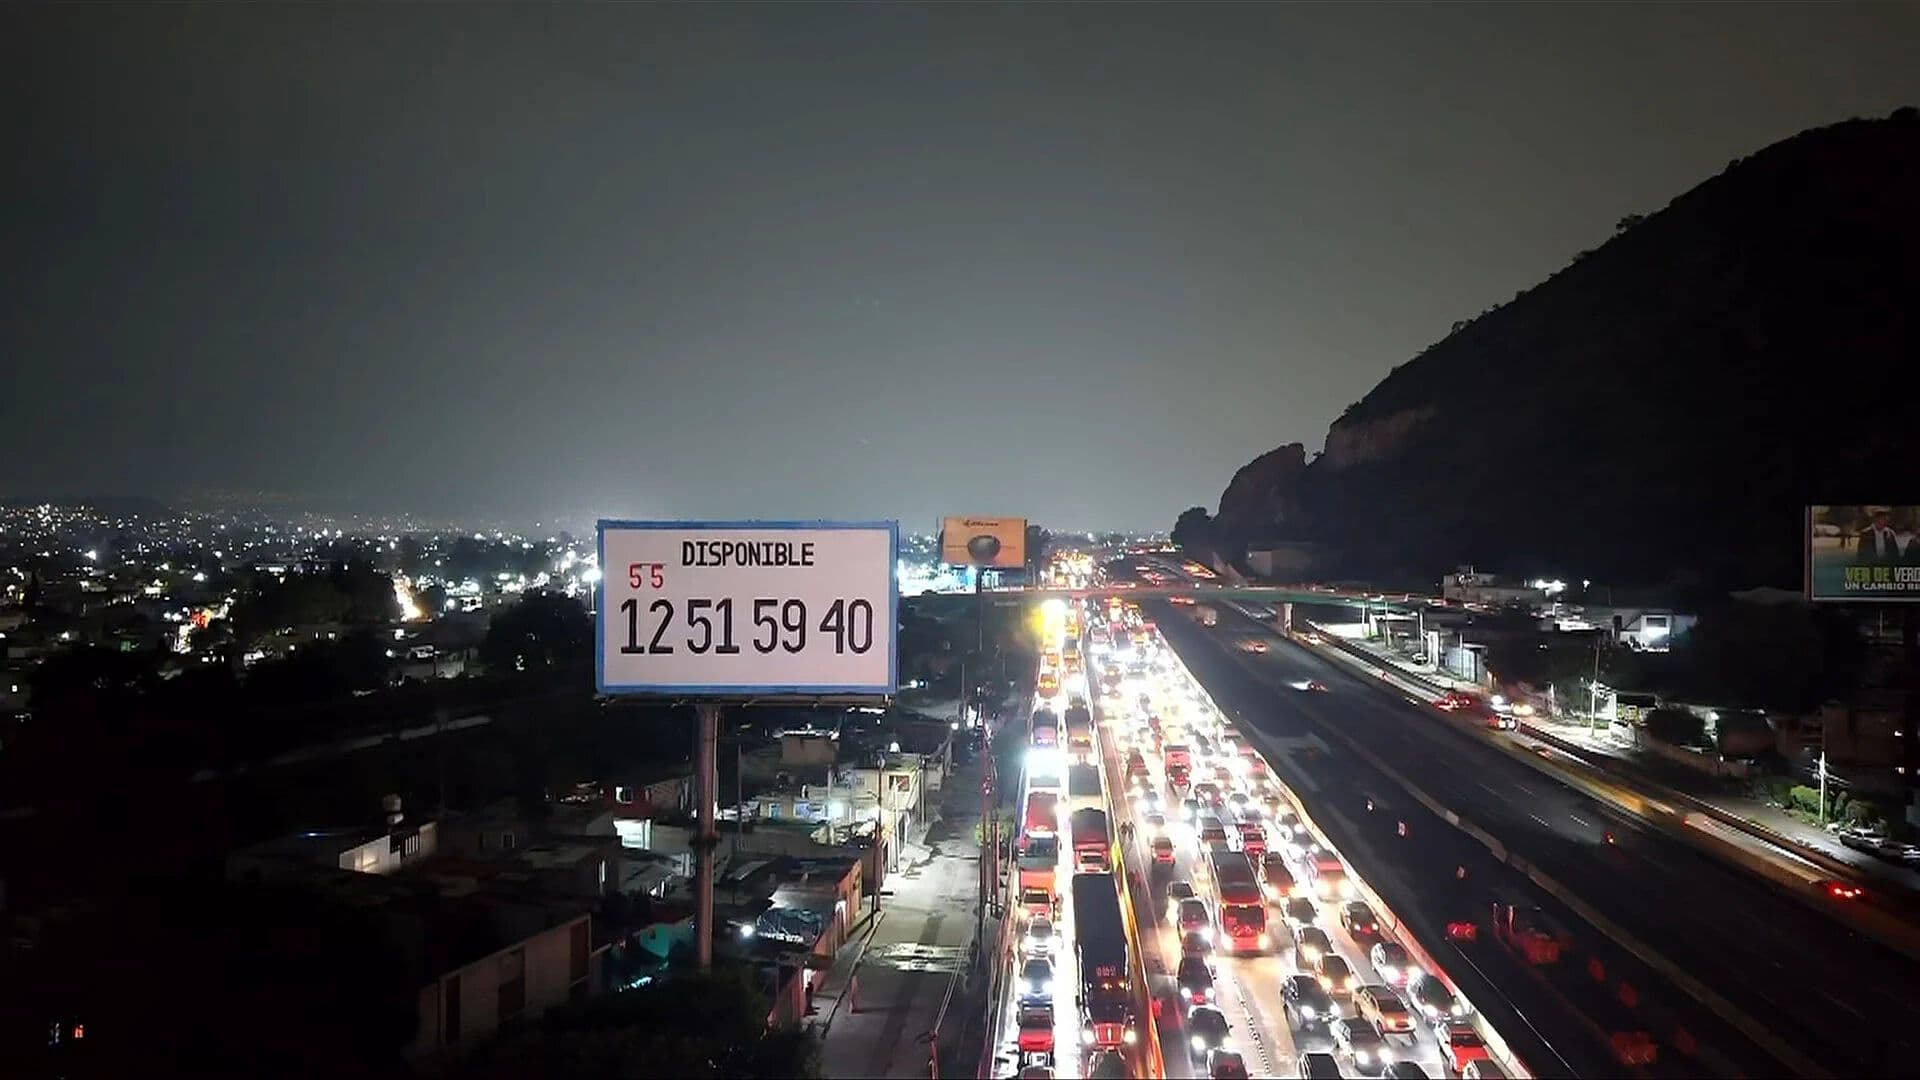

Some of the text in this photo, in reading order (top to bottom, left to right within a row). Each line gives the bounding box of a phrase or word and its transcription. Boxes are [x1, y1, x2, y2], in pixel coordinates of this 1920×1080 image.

[682, 541, 815, 567] DISPONIBLE
[1844, 582, 1860, 591] UN
[1862, 582, 1906, 591] CAMBIO
[620, 598, 873, 654] 12 51 59 40
